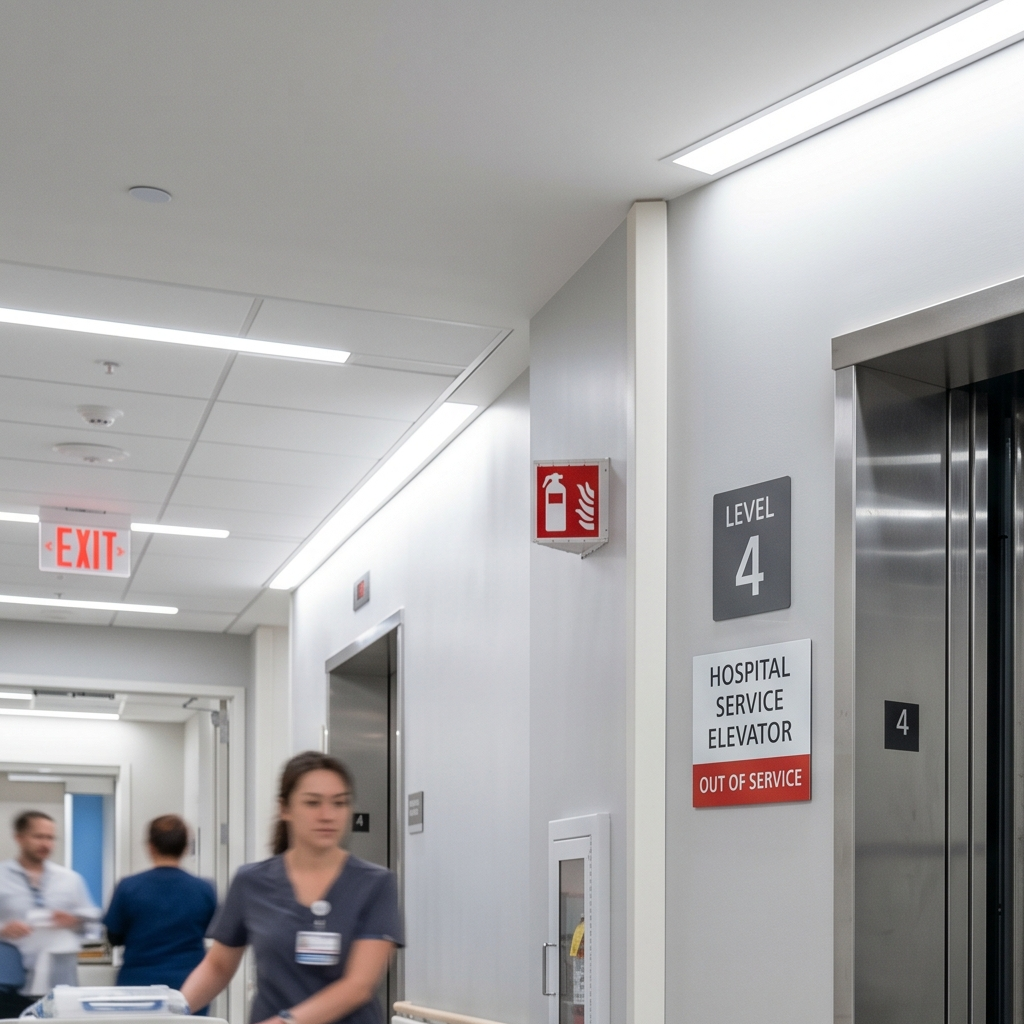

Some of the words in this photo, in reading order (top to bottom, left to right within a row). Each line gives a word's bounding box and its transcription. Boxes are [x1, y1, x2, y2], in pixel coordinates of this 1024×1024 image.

[725, 495, 775, 528] LEVEL
[56, 527, 118, 571] EXIT
[735, 534, 765, 597] 4
[709, 656, 791, 688] HOSPITAL
[715, 688, 784, 718] SERVICE
[708, 720, 793, 750] ELEVATOR
[895, 708, 910, 736] 4
[699, 774, 726, 794] OUT
[728, 772, 746, 792] OF
[748, 768, 803, 790] SERVICE
